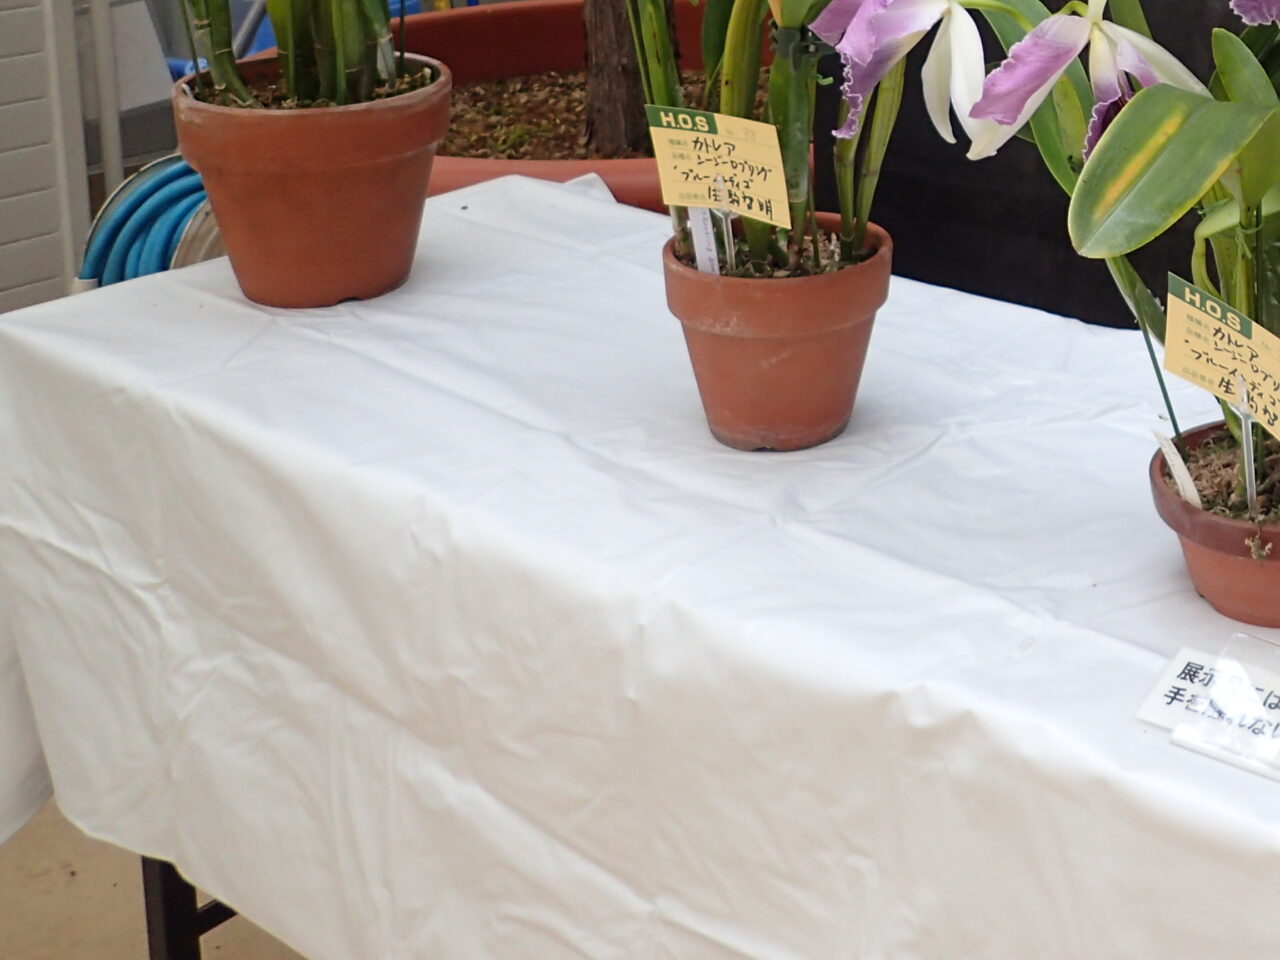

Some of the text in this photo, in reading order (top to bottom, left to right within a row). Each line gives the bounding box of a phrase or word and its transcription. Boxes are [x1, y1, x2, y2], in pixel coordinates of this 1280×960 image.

[659, 111, 710, 132] H.O.S
[692, 136, 736, 157] カトレア
[1184, 286, 1242, 332] H.O.S
[1212, 325, 1260, 362] カトレア
